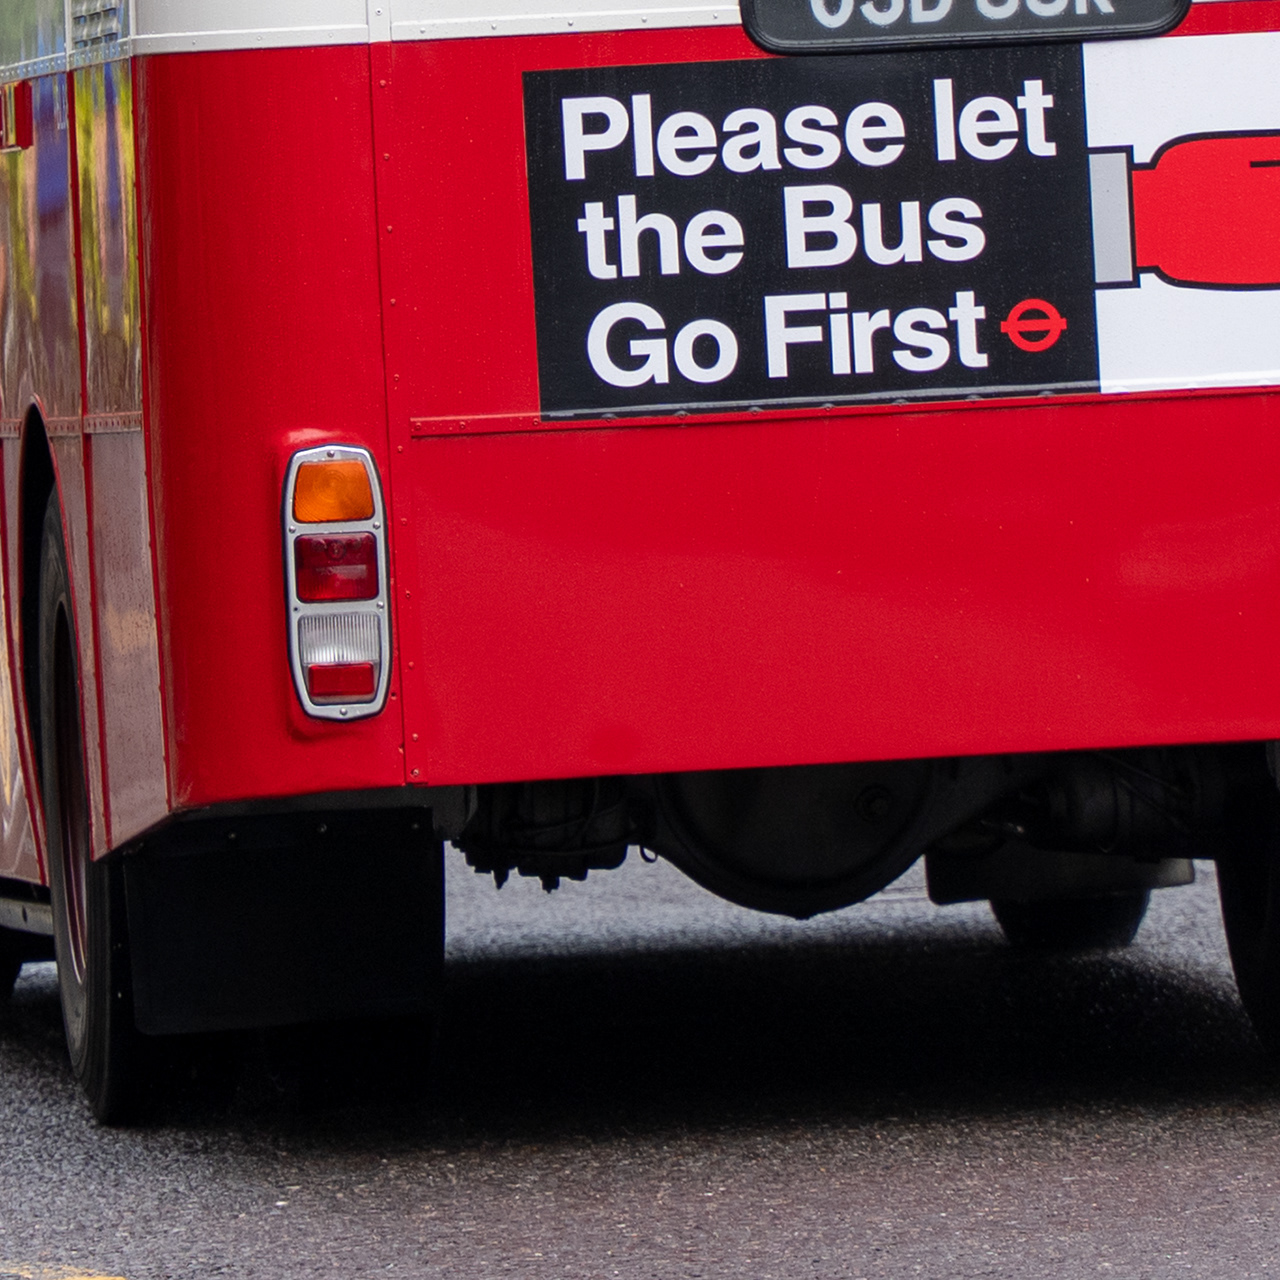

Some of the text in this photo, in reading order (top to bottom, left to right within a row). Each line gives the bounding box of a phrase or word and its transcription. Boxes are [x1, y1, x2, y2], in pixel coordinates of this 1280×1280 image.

[561, 78, 1057, 180] Please let
[577, 184, 986, 280] the Bus
[587, 290, 989, 388] Go First
